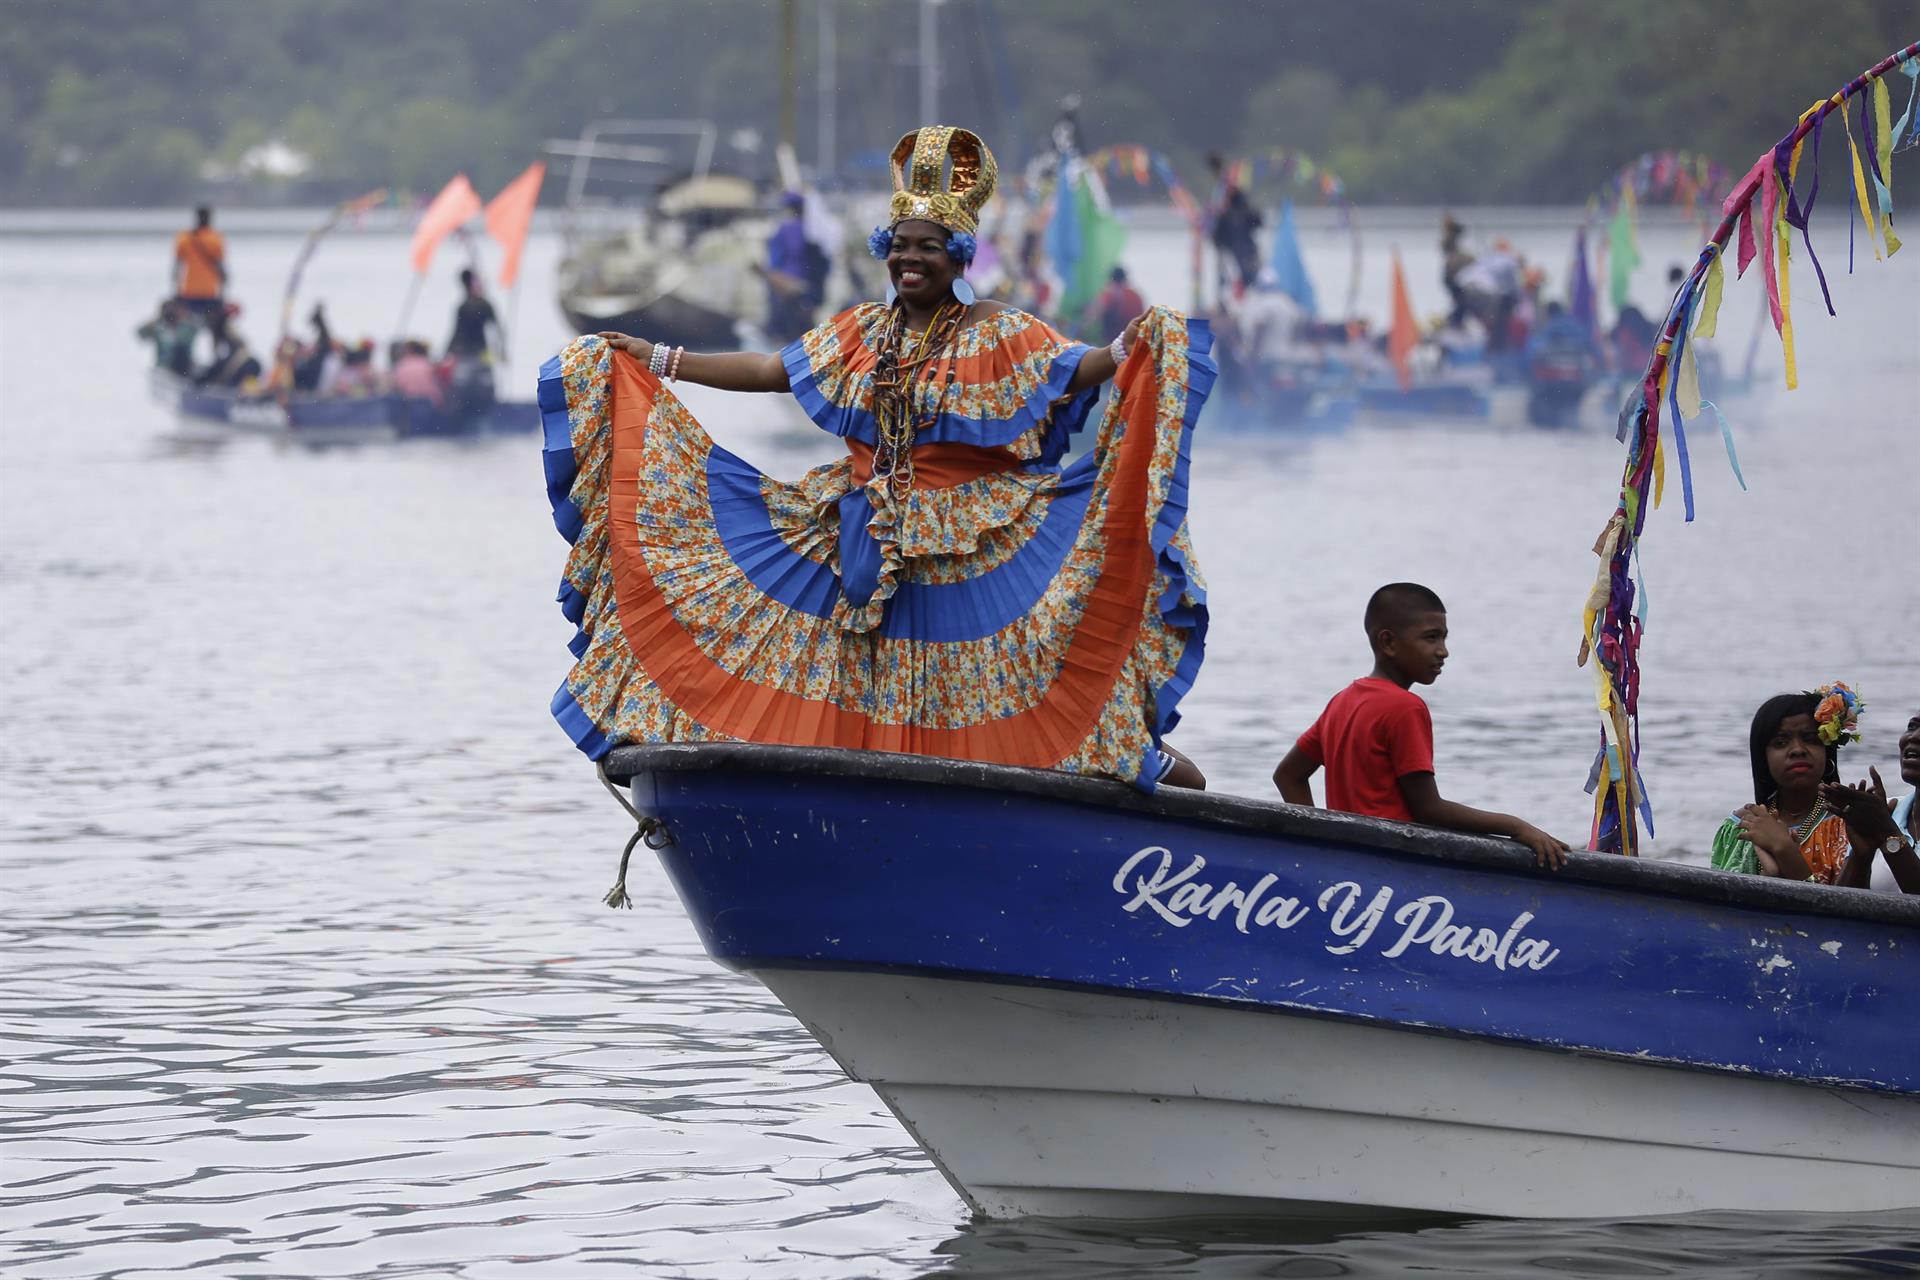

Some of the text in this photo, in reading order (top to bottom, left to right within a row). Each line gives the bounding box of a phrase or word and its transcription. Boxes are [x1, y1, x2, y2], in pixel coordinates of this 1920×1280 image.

[1112, 845, 1560, 971] Karla Y Paola
